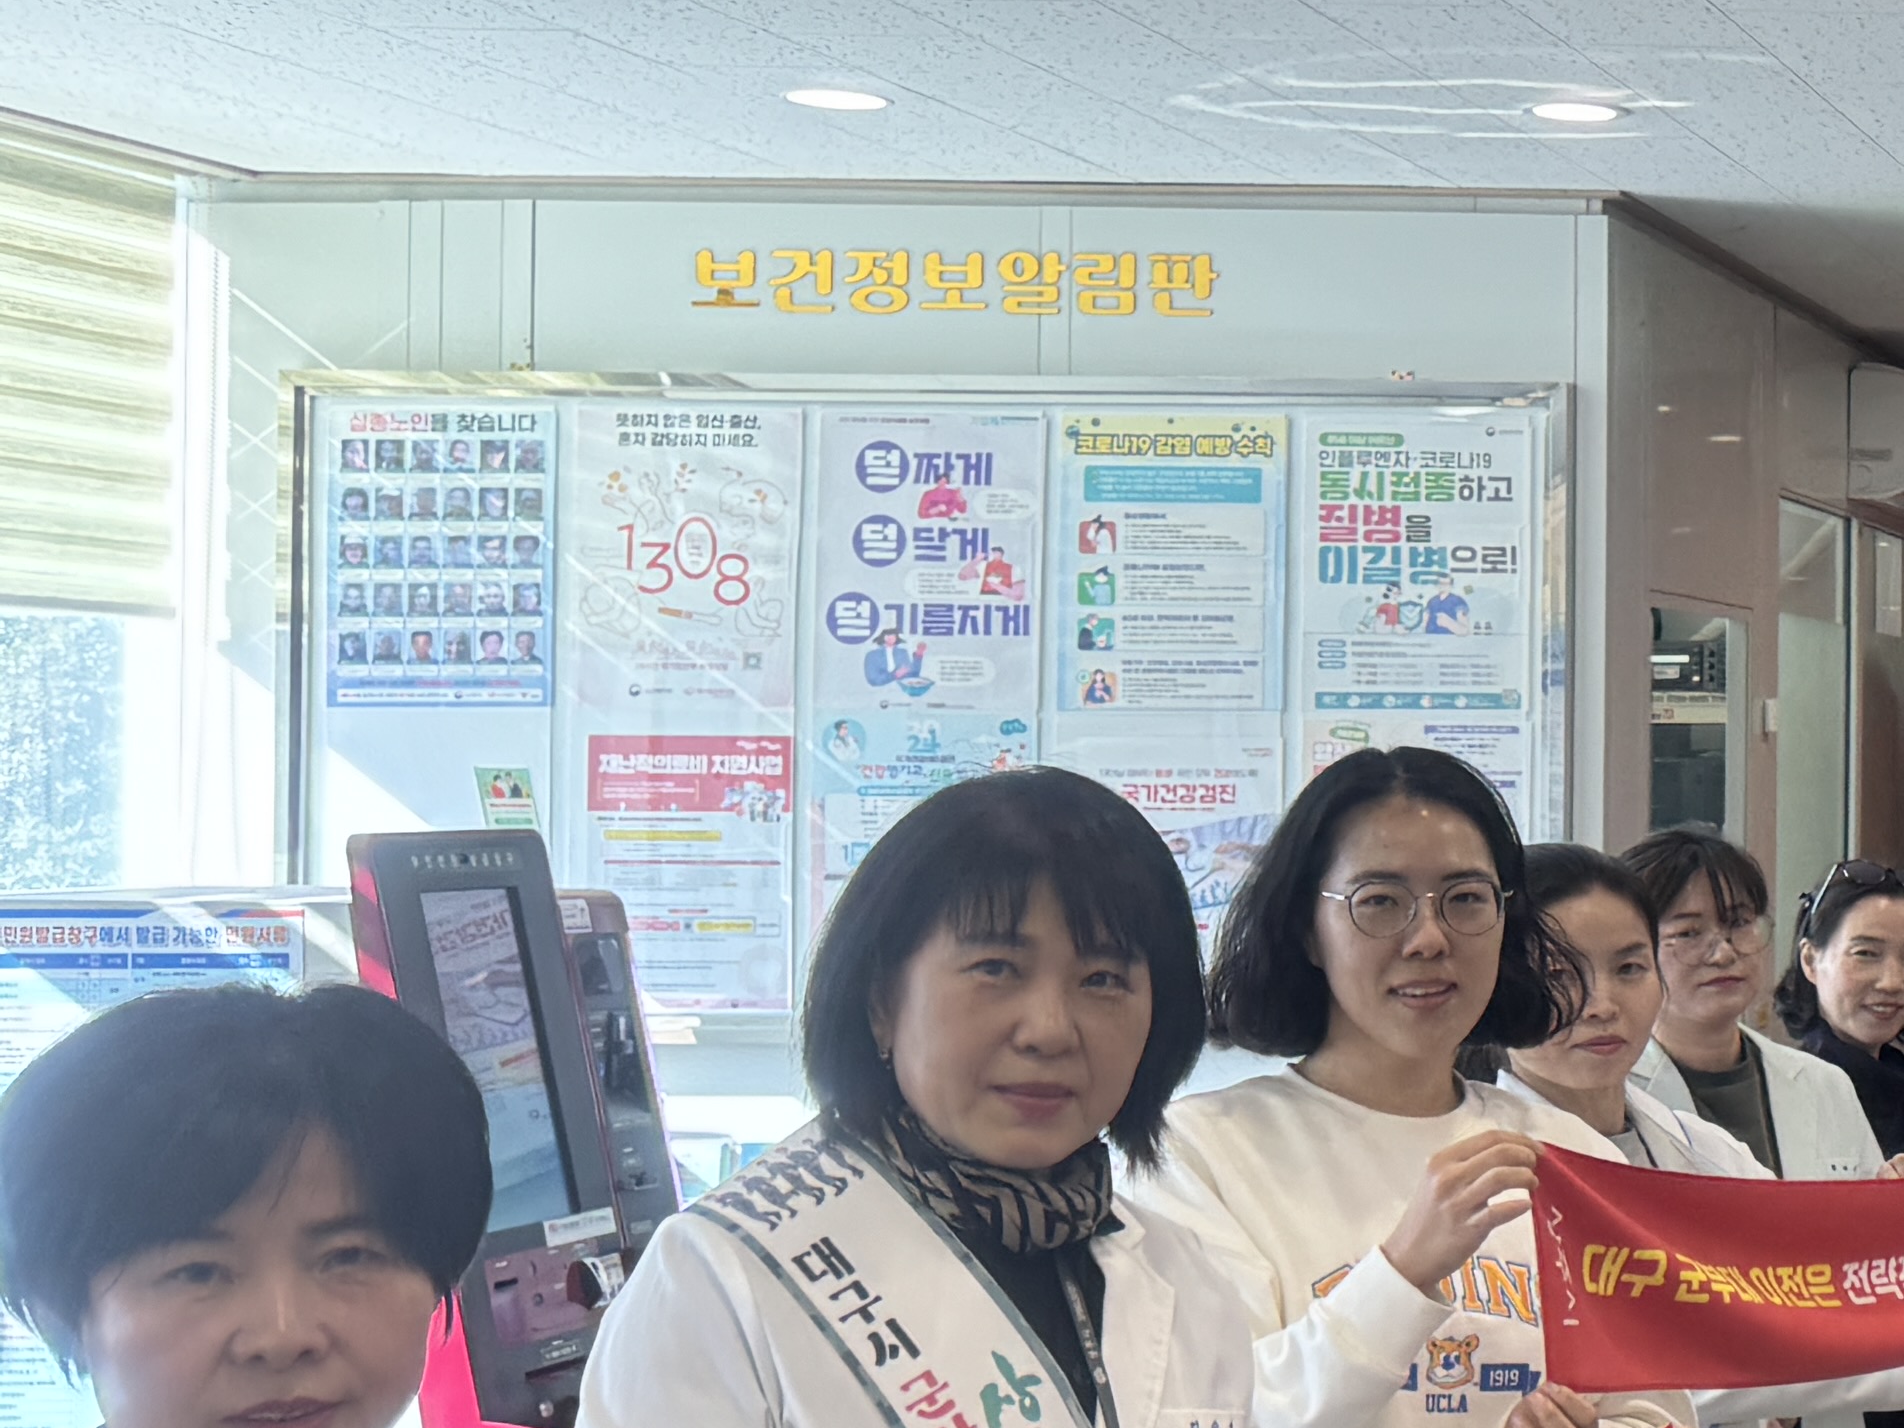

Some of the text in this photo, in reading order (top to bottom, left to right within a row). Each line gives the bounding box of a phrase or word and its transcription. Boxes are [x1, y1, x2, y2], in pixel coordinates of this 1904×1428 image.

[690, 247, 1221, 317] 보건정보알림판
[349, 413, 538, 434] 실종노인을 찾습니다
[663, 414, 692, 428] 않은
[1075, 433, 1274, 458] 코로나19 감염 예방 수칙
[863, 449, 993, 486] 덜 짜게
[1319, 470, 1513, 502] 동시접종하고
[1318, 503, 1433, 544] 질병을
[617, 516, 751, 606] 1308
[861, 523, 990, 562] 덜 달게
[834, 600, 1030, 637] 덜 기름지게
[0, 925, 130, 947] 민원발급창구에서
[1582, 1244, 1668, 1297] 대구
[1749, 1263, 1843, 1308] 이전은
[790, 1235, 922, 1368] 대구시
[1489, 1369, 1520, 1386] 1919
[1425, 1393, 1469, 1414] UCLA
